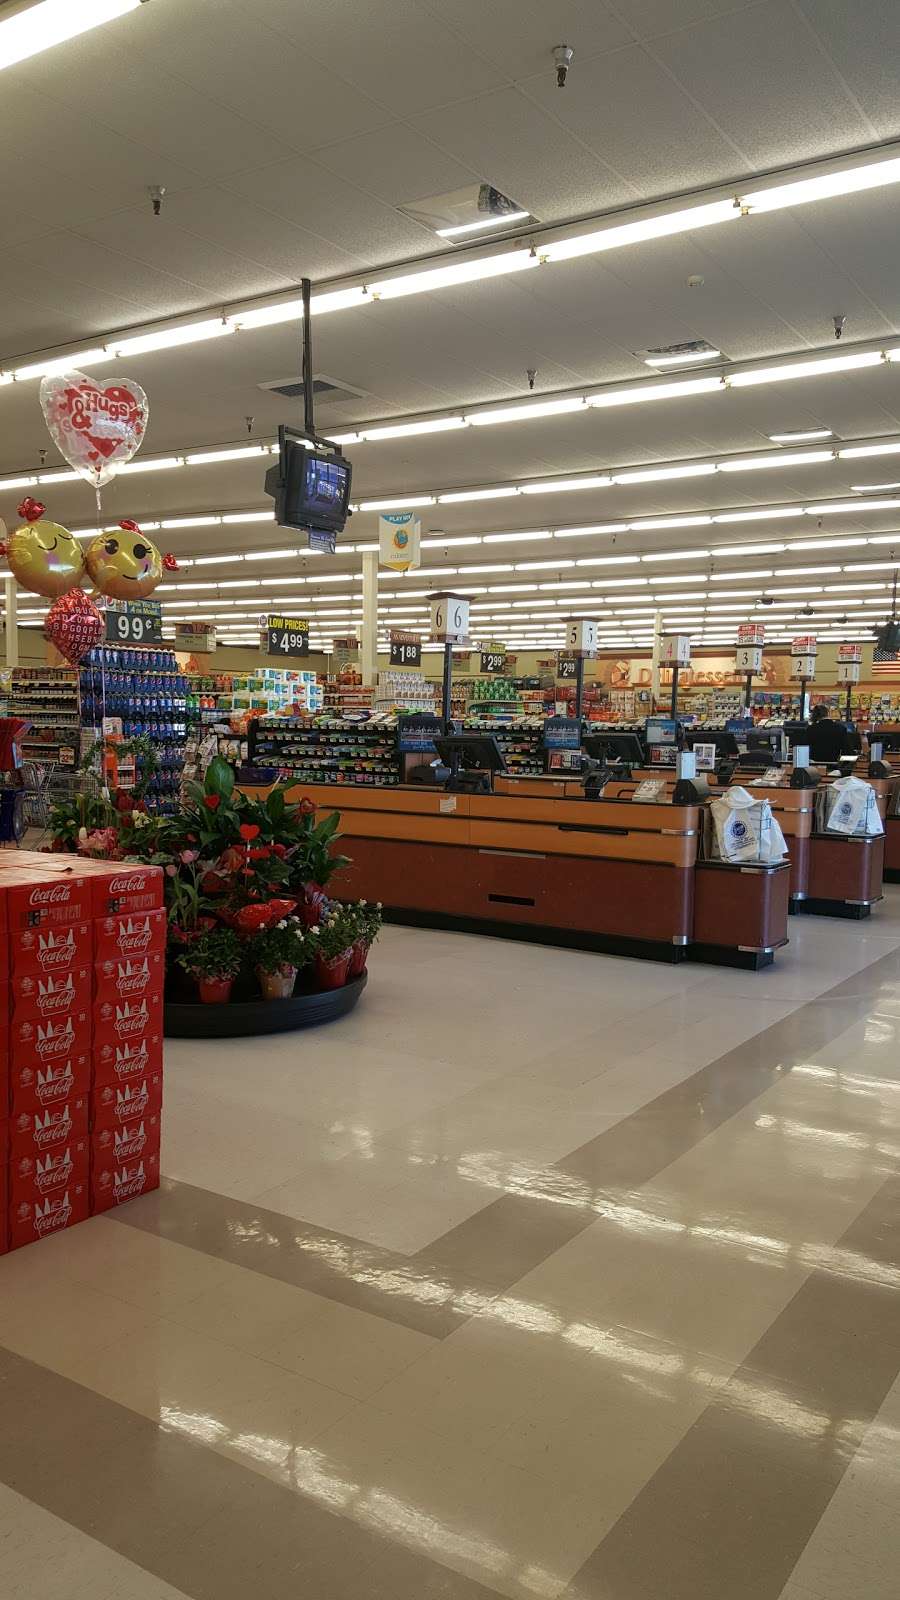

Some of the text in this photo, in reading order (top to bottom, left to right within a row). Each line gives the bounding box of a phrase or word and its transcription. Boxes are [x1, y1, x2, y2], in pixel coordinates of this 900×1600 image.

[85, 392, 129, 421] Hugs
[435, 604, 443, 628] 6
[454, 606, 462, 629] 6
[269, 617, 309, 632] LOW PRICES!
[570, 627, 577, 644] 5
[667, 643, 673, 657] 4
[742, 652, 748, 665] 3
[797, 660, 802, 672] 2
[844, 667, 848, 678] 1
